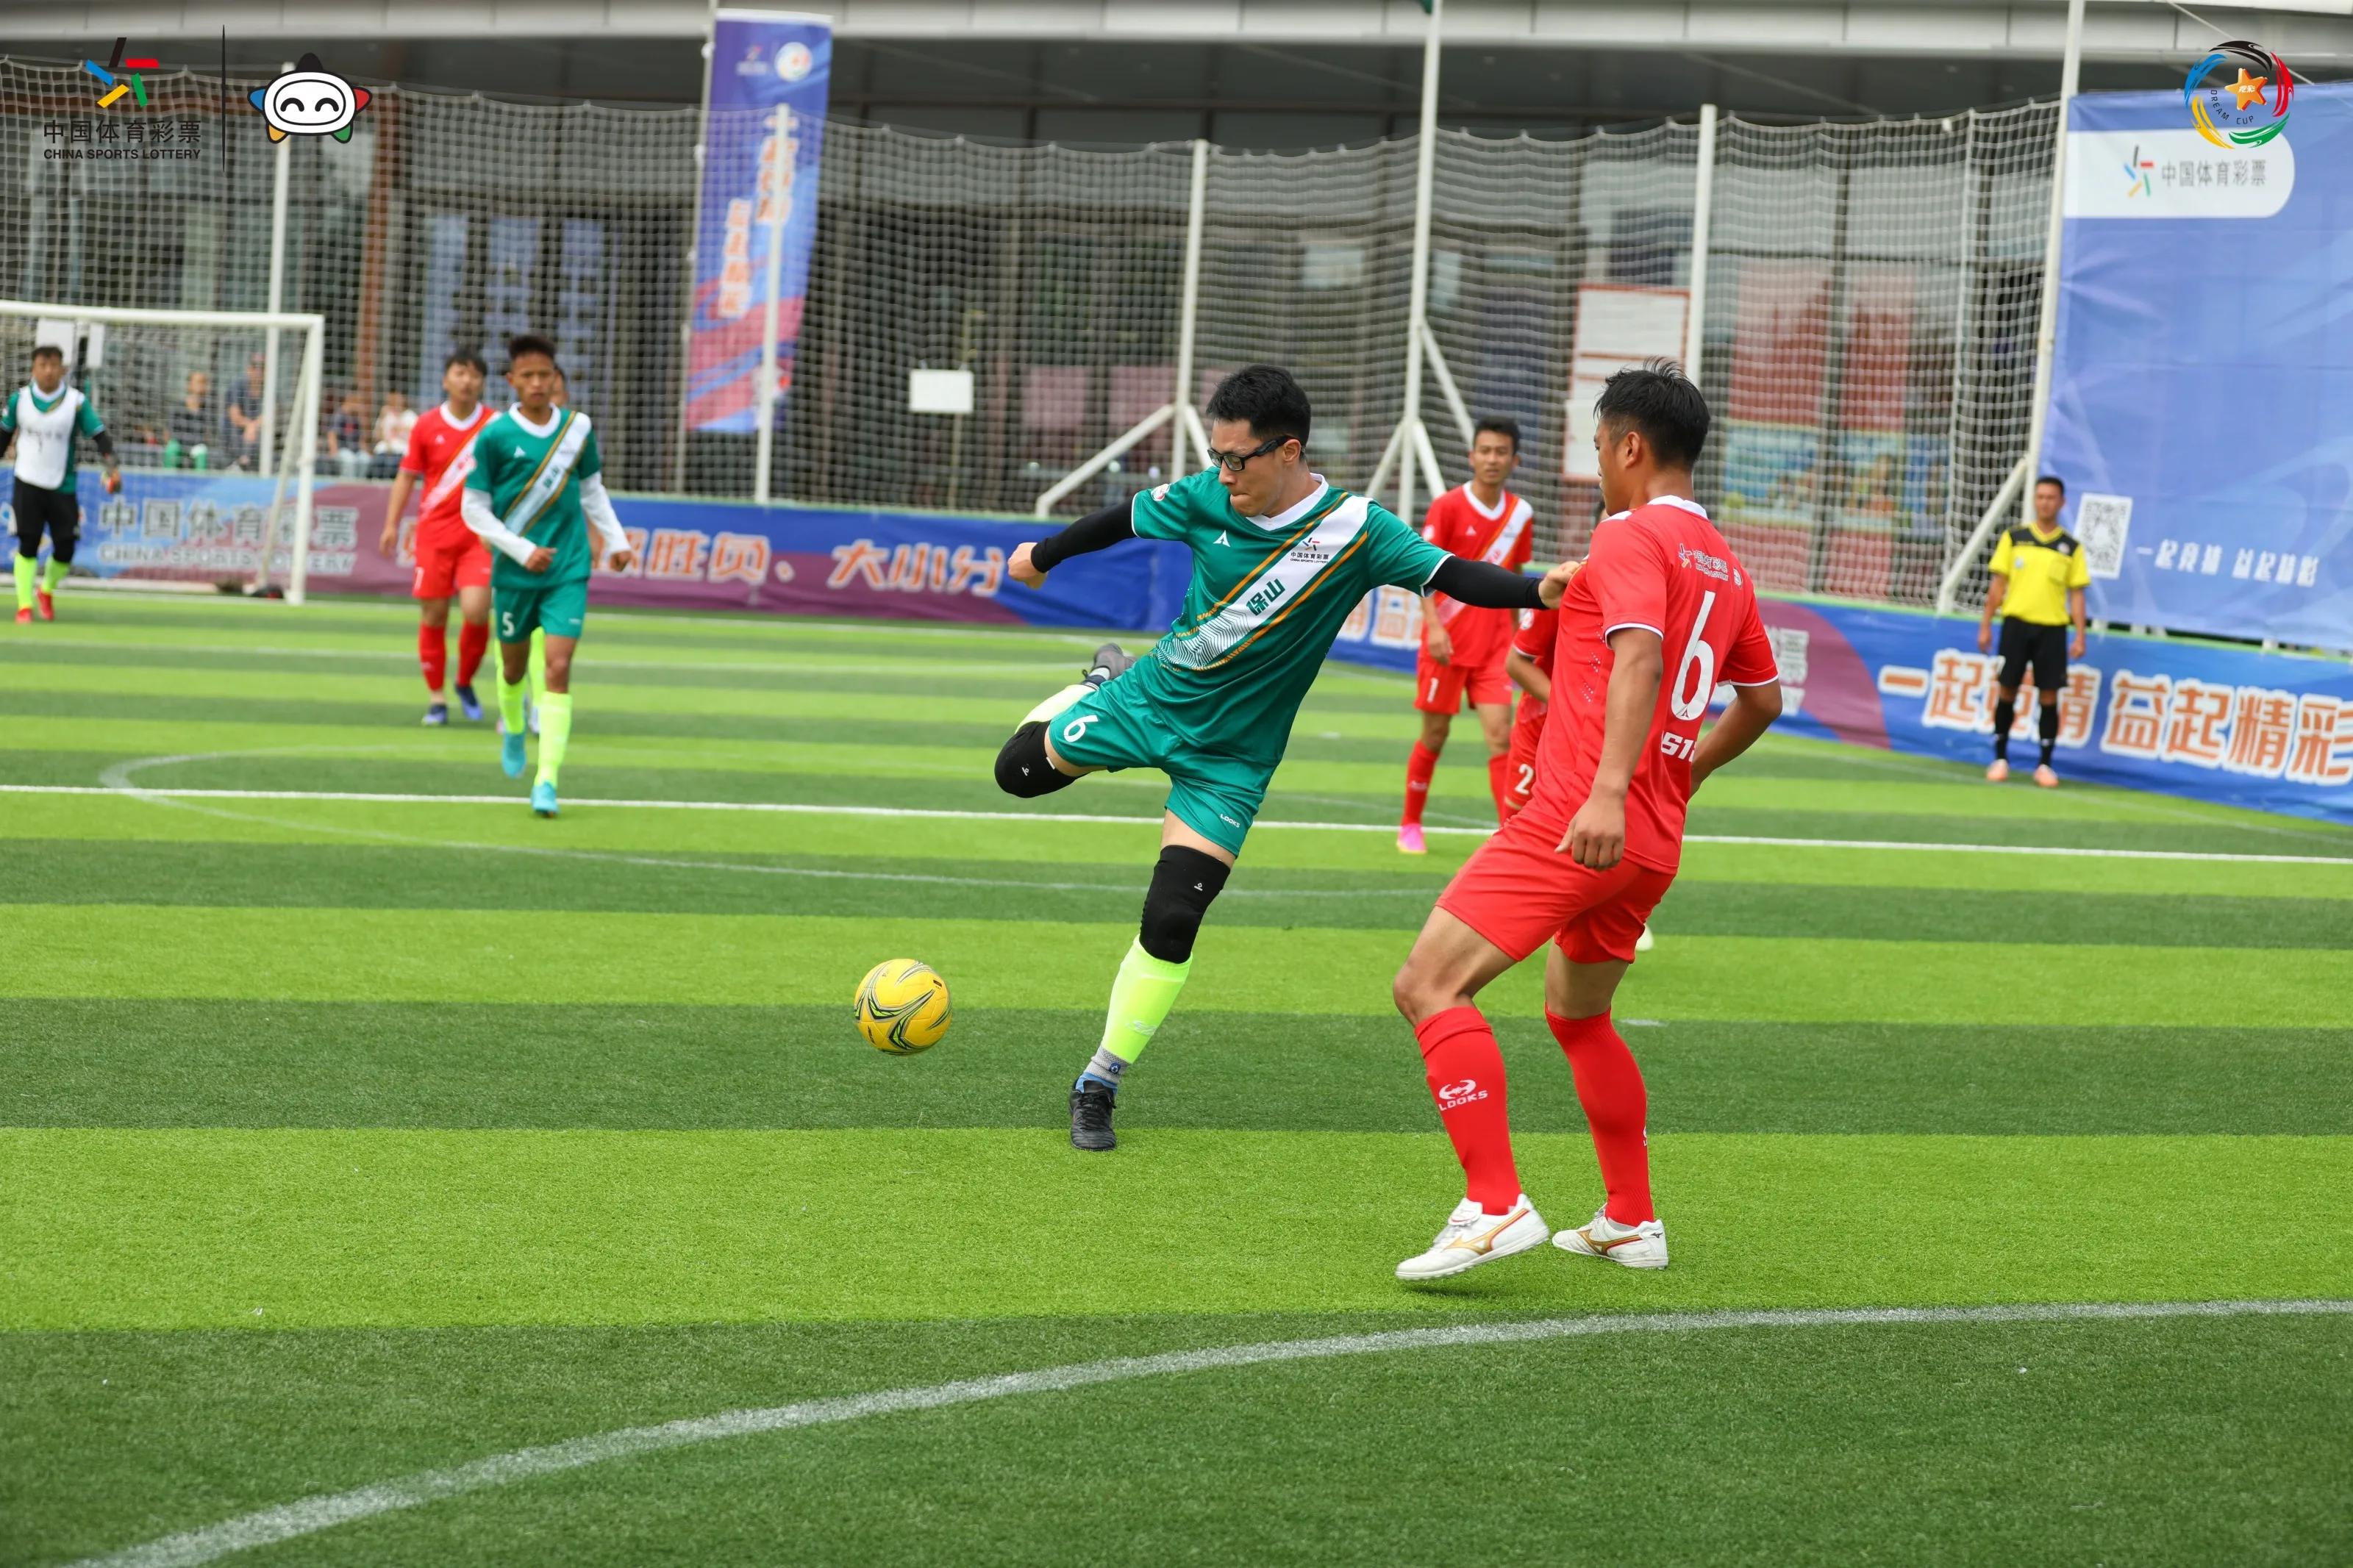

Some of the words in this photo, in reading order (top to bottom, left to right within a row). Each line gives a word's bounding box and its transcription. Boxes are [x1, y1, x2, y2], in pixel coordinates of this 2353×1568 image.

[2162, 160, 2266, 187] 中国体育彩票
[1290, 552, 1329, 560] 中国体育彩票
[1246, 578, 1286, 616] 保山
[502, 612, 515, 637] 5
[1671, 590, 1716, 721] 6
[1427, 677, 1439, 703] 1
[1063, 715, 1099, 742] 6
[2100, 670, 2353, 786] 益起精彩
[1515, 764, 1534, 795] 2
[1220, 813, 1240, 828] LOOKS
[1438, 1089, 1488, 1111] LOOKS
